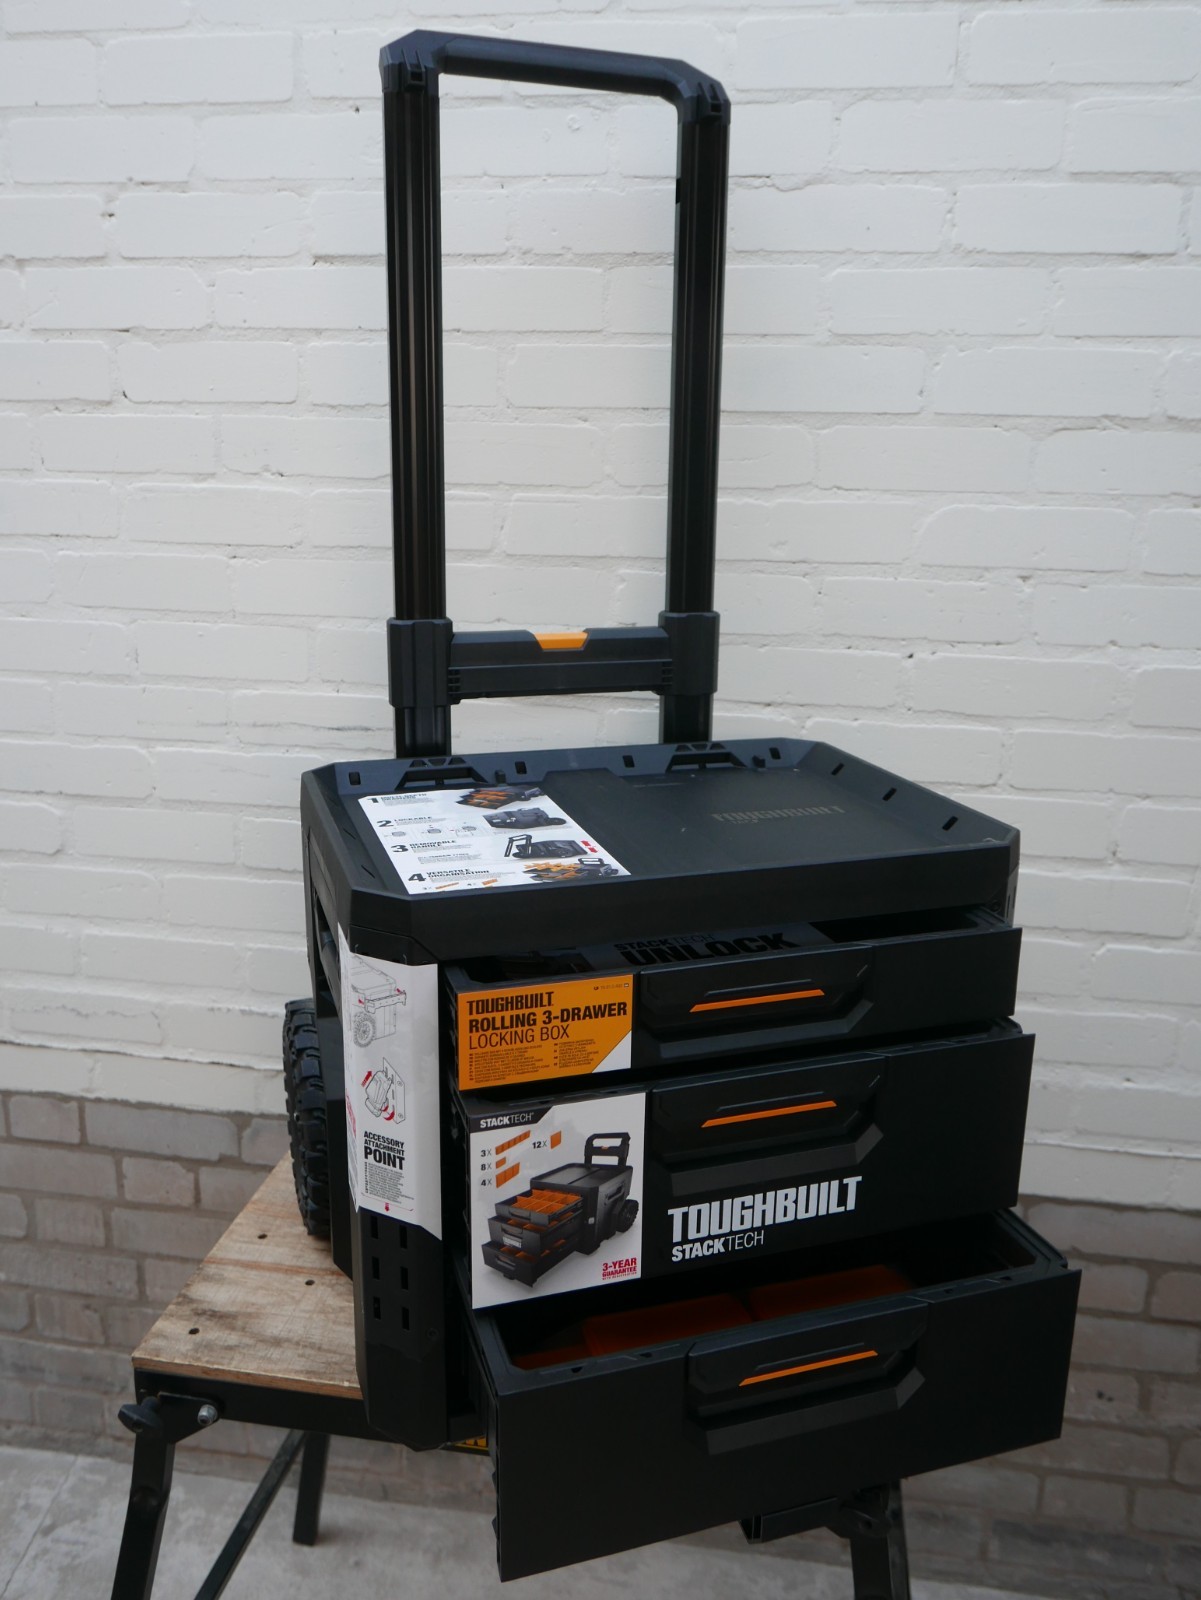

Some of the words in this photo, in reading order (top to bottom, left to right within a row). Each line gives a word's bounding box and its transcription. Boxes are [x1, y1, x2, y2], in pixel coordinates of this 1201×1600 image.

[391, 844, 408, 852] 3
[408, 873, 426, 882] 4
[613, 933, 714, 950] STACKTECH
[620, 932, 799, 966] UNLOCK
[467, 991, 554, 1016] TOUGHBUILT
[469, 1012, 537, 1033] ROLLING
[542, 1001, 628, 1025] 3-DRAWER
[469, 1028, 535, 1050] LOCKING
[540, 1024, 570, 1042] BOX
[480, 1112, 534, 1129] STACKTECH
[363, 1130, 405, 1149] ACCESSORY
[364, 1138, 405, 1156] ATTACHMENT
[364, 1145, 405, 1171] POINT
[668, 1175, 862, 1243] TOUGHBUILT
[671, 1230, 764, 1262] STACKTECH
[602, 1257, 637, 1272] 3-YEAR
[602, 1266, 637, 1278] GUARANTEE
